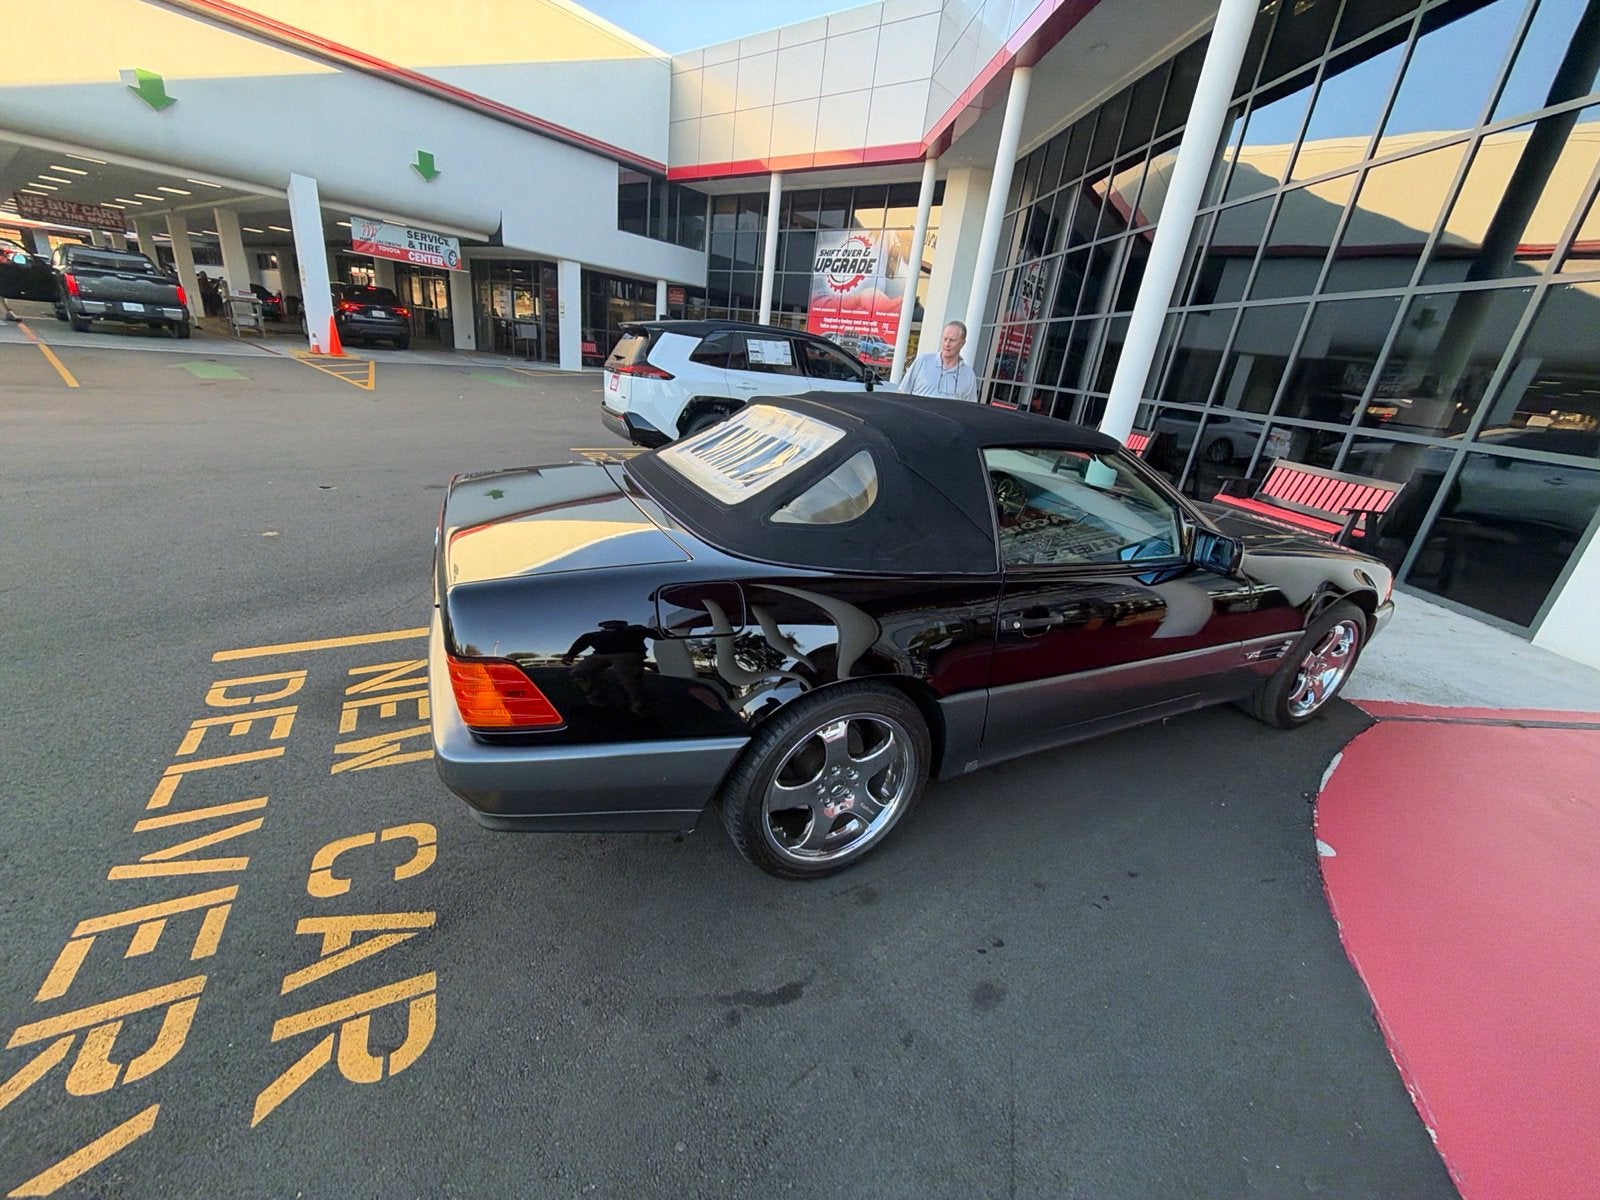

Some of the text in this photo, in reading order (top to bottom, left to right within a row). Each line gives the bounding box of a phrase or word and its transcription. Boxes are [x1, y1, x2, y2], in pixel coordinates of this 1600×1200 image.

[81, 205, 121, 220] CARS
[406, 230, 450, 247] SERVICE
[378, 245, 400, 254] TOYOTA
[407, 239, 442, 254] & TIRE
[819, 249, 841, 257] SHIFT
[842, 249, 862, 257] OVER
[408, 251, 444, 266] CENTER
[813, 257, 877, 274] UPGRADE
[251, 658, 437, 1128] NEW CAR
